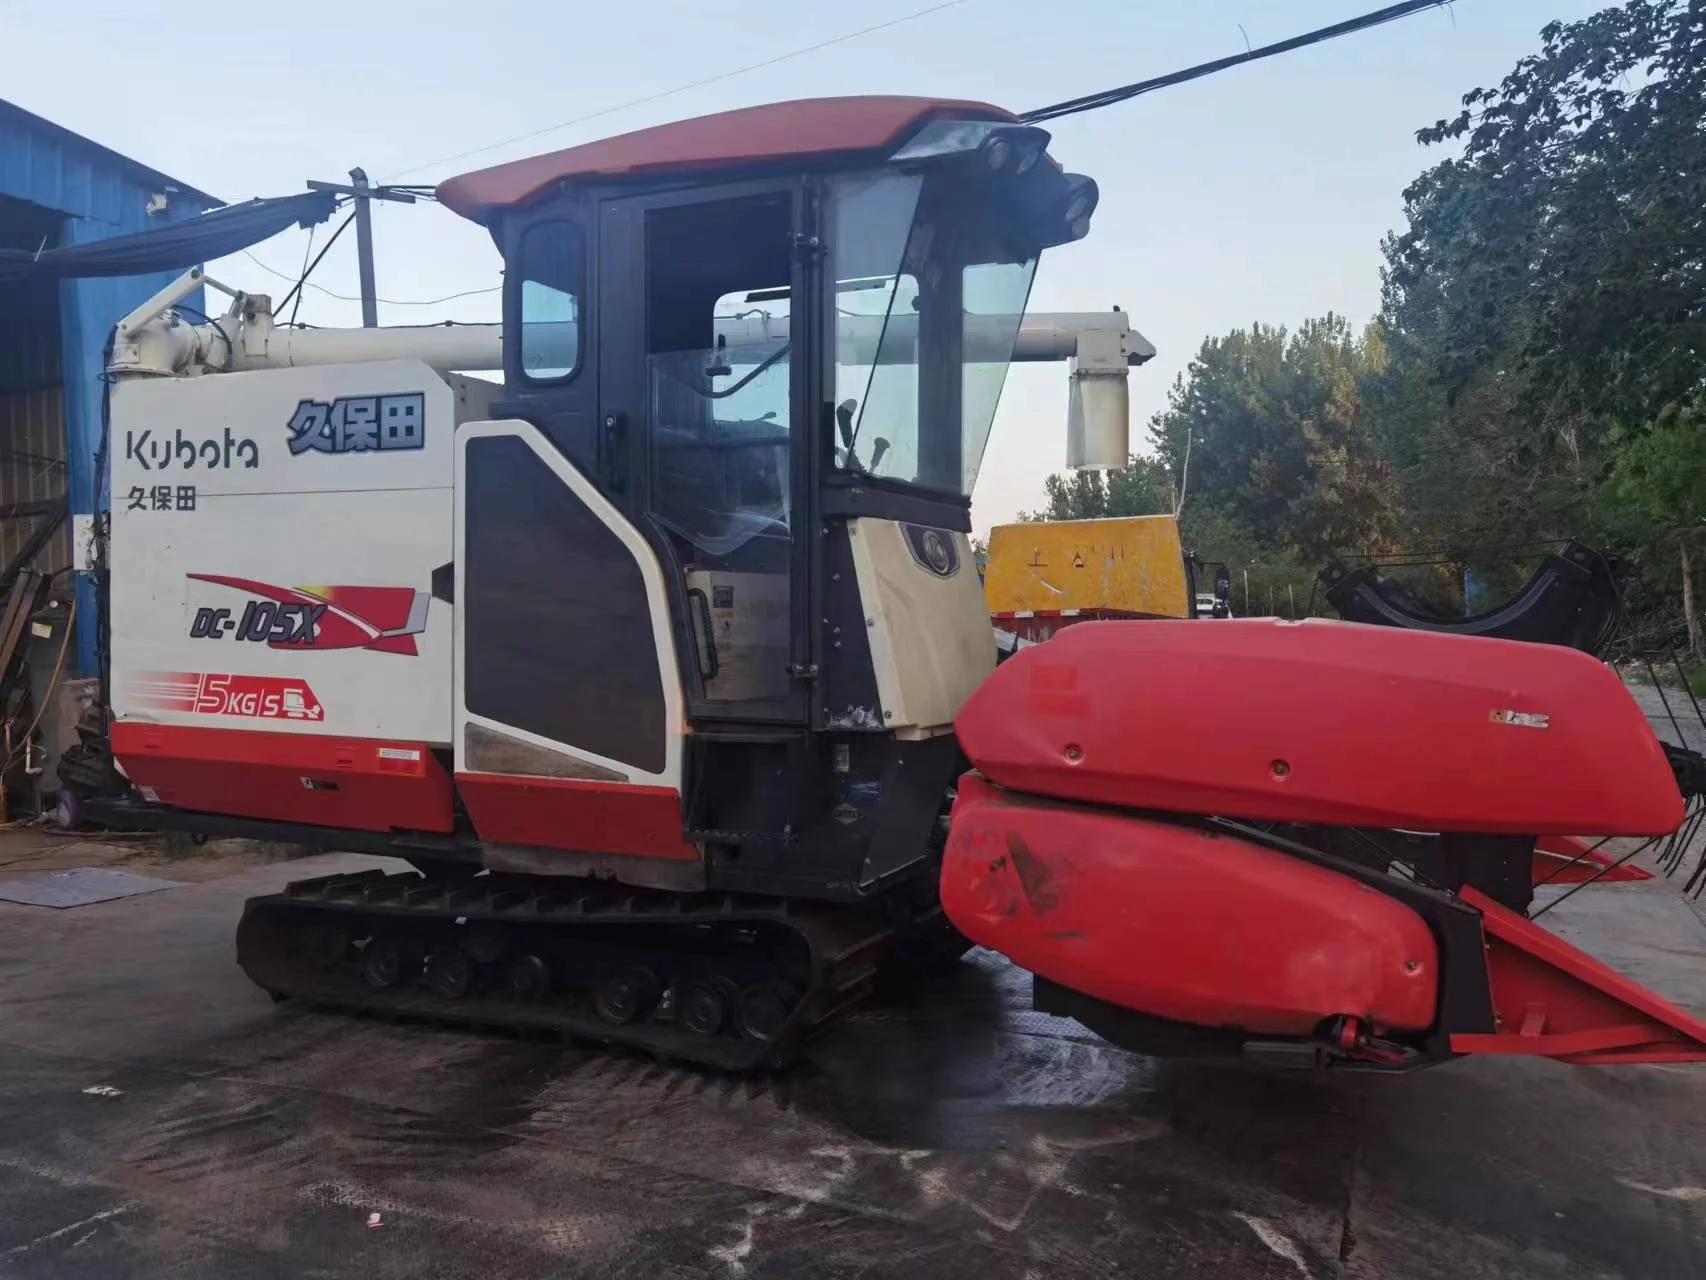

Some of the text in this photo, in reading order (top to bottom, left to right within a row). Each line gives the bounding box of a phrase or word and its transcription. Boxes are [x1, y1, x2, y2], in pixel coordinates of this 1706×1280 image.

[287, 391, 425, 455] 久保田
[126, 427, 259, 470] Kubota
[127, 485, 196, 511] 久保田
[190, 600, 327, 643] DC-105X
